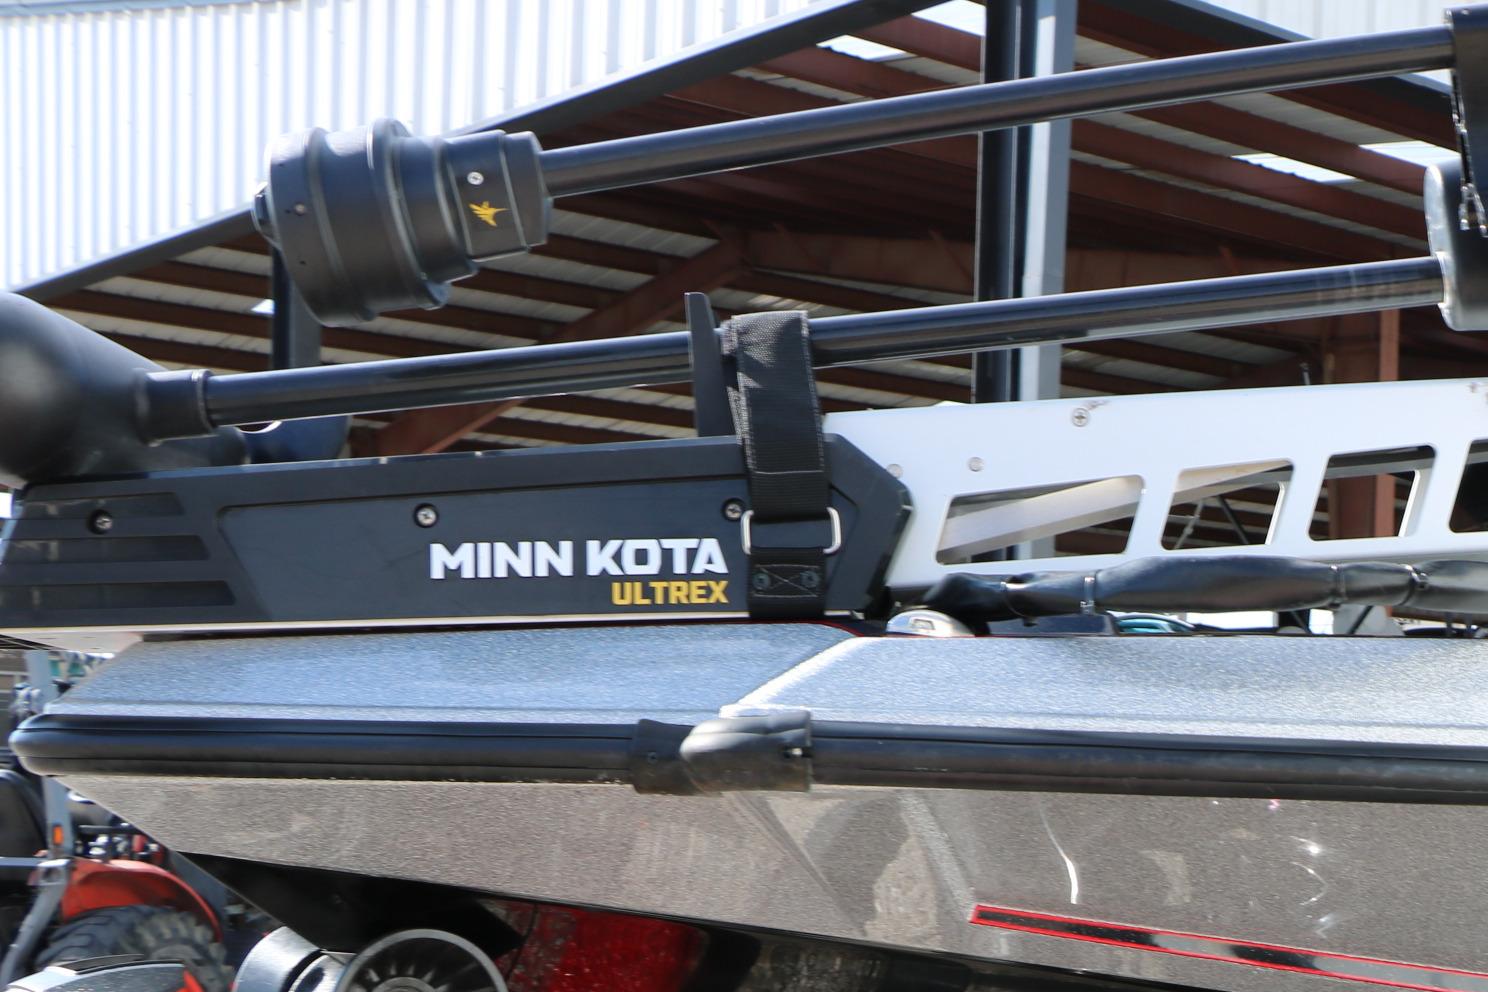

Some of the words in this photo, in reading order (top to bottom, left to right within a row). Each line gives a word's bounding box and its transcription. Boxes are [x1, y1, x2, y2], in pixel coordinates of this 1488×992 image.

[430, 540, 574, 579] MINN
[586, 538, 729, 576] KOTA
[611, 580, 729, 605] ULTREX
